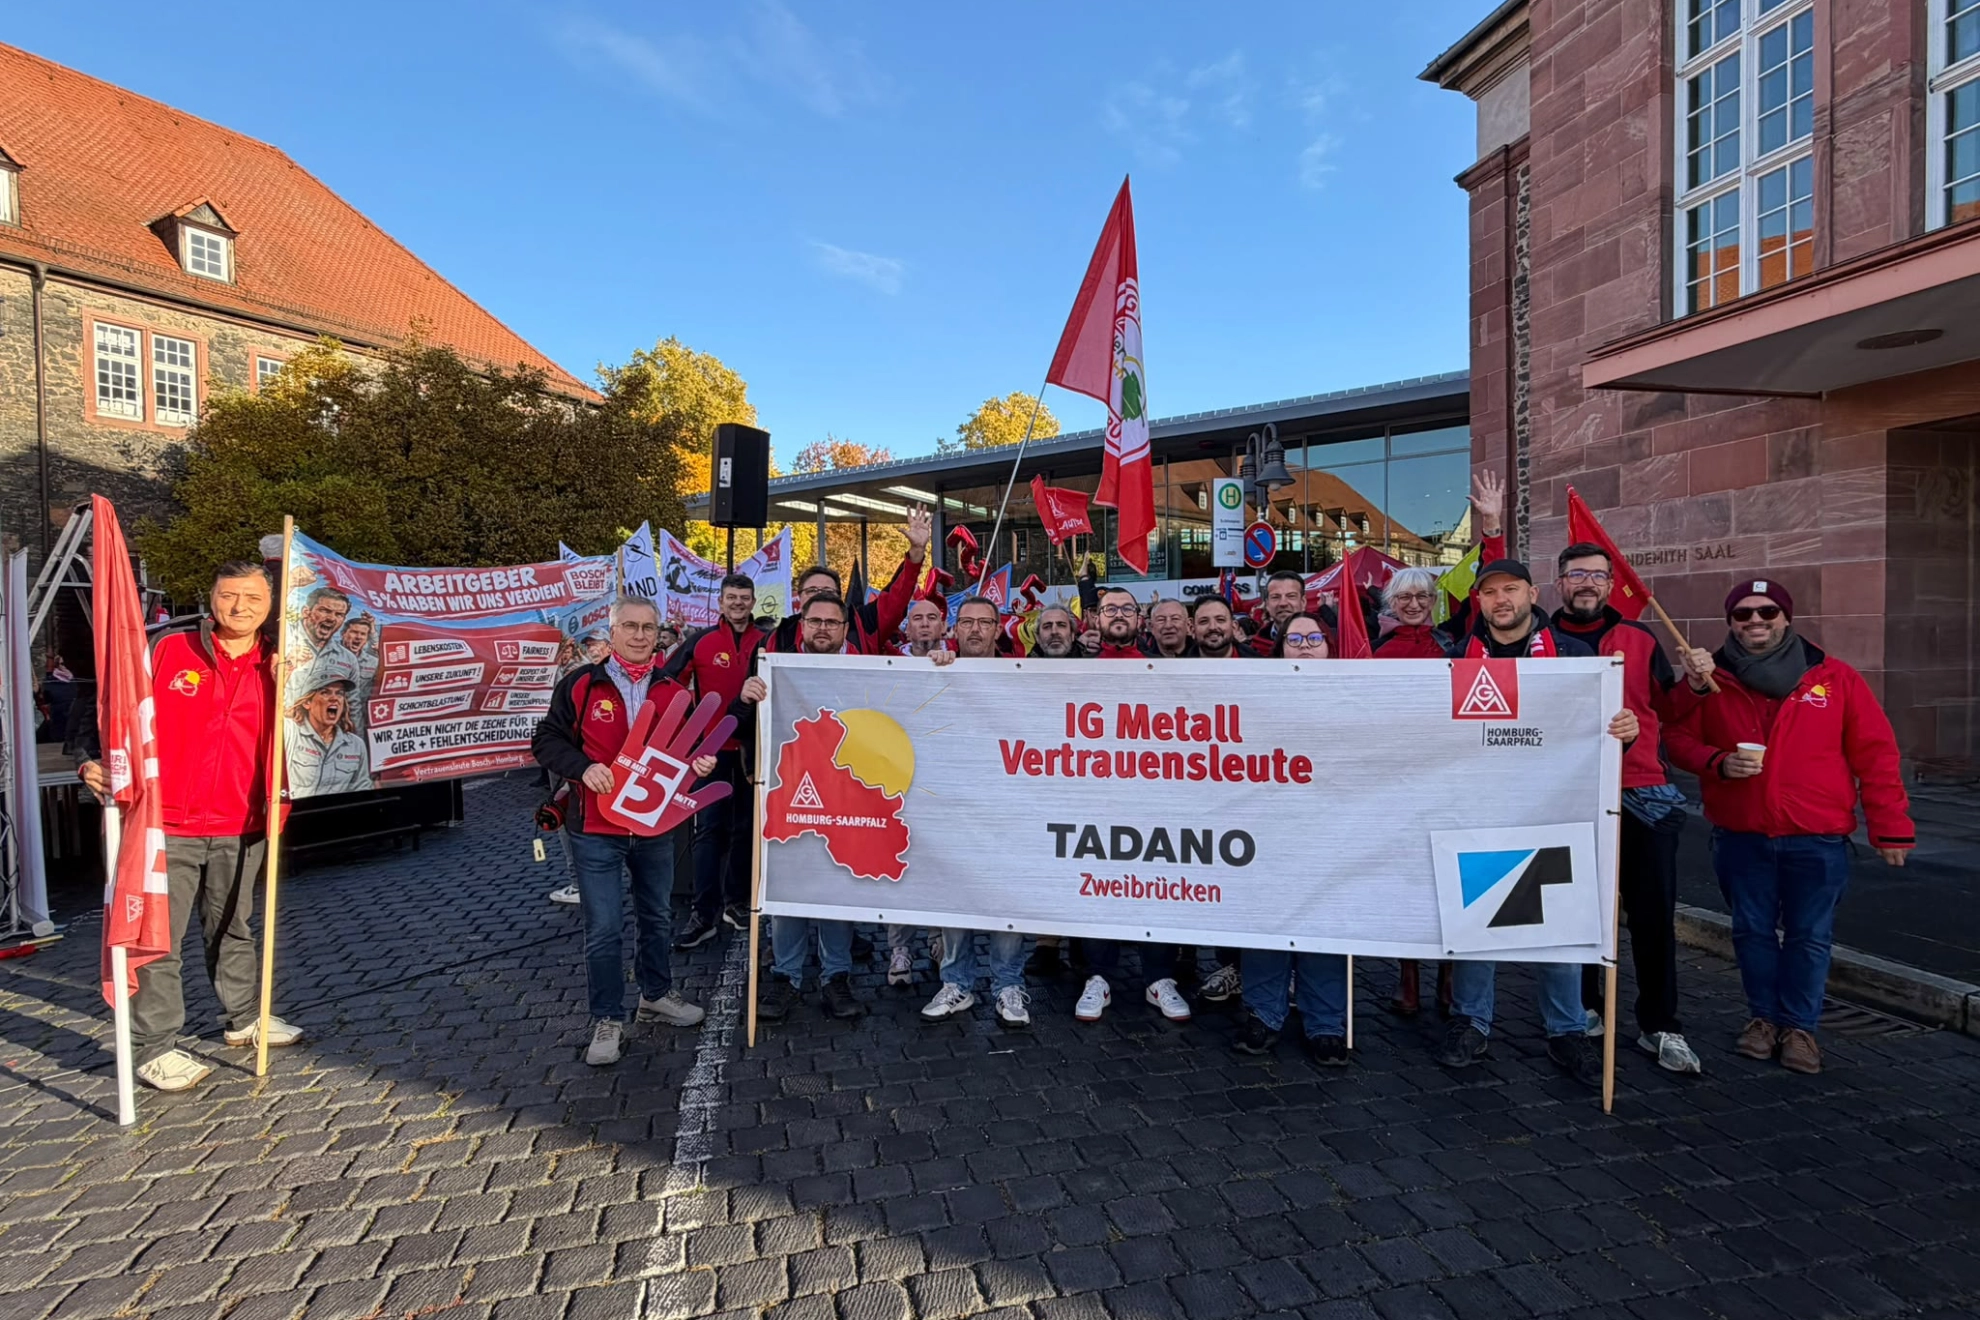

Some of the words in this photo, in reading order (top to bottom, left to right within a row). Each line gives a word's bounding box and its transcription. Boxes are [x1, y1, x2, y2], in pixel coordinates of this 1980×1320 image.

[1225, 488, 1236, 504] H
[1623, 549, 1687, 567] NDEMITH
[1695, 544, 1736, 560] SAAL
[384, 566, 539, 594] ARBEITGEBER
[570, 569, 606, 580] BOSCH
[573, 580, 606, 590] BLEIBT
[1182, 583, 1251, 596] CONGSS
[367, 590, 398, 609] 5%
[396, 595, 447, 612] HABEN
[446, 595, 476, 612] WIR
[476, 592, 505, 609] UNS
[505, 581, 567, 606] VERDIENT
[415, 672, 443, 683] UNSERE
[373, 730, 393, 744] WIR
[396, 725, 432, 740] ZAHLEN
[434, 721, 463, 735] NICHT
[465, 720, 480, 731] DIE
[481, 718, 508, 730] ZECHE
[509, 715, 528, 728] FÜR
[1065, 702, 1104, 739] IG
[1116, 703, 1243, 743] Metall
[1486, 737, 1543, 747] SAARPFALZ
[1487, 727, 1544, 738] HOMBURG-
[391, 740, 416, 754] GIER
[998, 739, 1313, 784] Vertrauensleute
[620, 756, 682, 814] 5
[786, 813, 888, 828] HOMBURG-SAARPFALZ
[1046, 822, 1256, 867] TADANO
[1078, 872, 1222, 902] Zweibrücken
